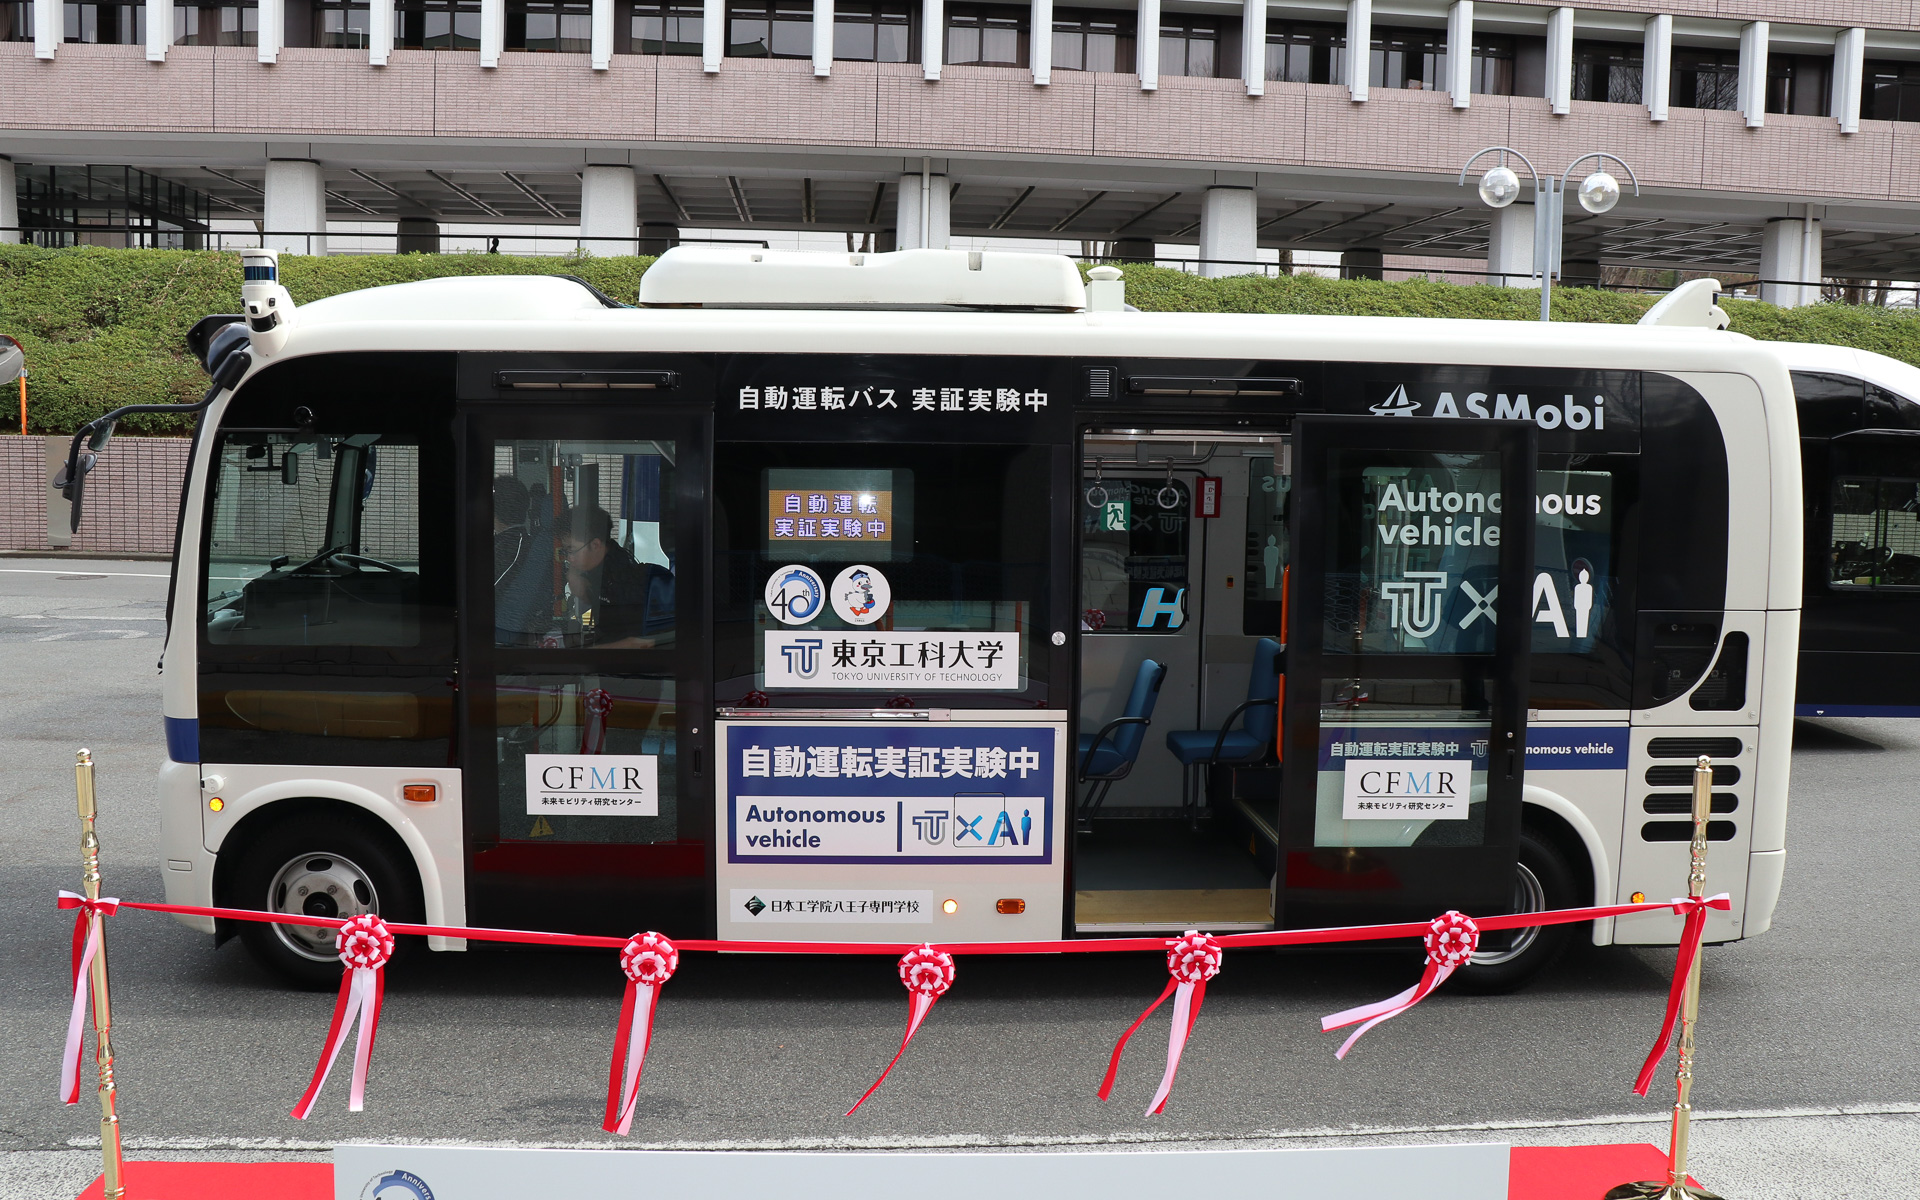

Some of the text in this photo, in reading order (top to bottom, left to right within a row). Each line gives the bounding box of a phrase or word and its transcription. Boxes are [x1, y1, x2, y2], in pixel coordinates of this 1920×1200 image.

[739, 386, 1048, 413] 自動運転バス 実証実験中
[1432, 392, 1604, 430] ASMobi
[785, 494, 878, 514] 自動運転
[1377, 483, 1602, 516] Autonoous
[774, 518, 886, 538] 実証実験中
[1378, 516, 1501, 546] vehicle
[831, 639, 1004, 669] 東京工科大学
[832, 672, 1003, 682] TOKYO UNIVERSITY OF TECHNOLOGY
[1330, 741, 1460, 757] 自動運転実証実験中
[1574, 742, 1614, 755] vehicle
[742, 745, 1040, 779] 自動運転実証実験中
[541, 765, 644, 790] CFMR
[1359, 770, 1457, 795] CFMR
[541, 797, 642, 806] 未来モビリティ研究センター
[1357, 801, 1454, 811] 未来モビリティ研究センター
[745, 804, 886, 824] Autonomous
[745, 829, 821, 848] vehicle
[771, 899, 920, 914] 日本工学院八王子専門学校
